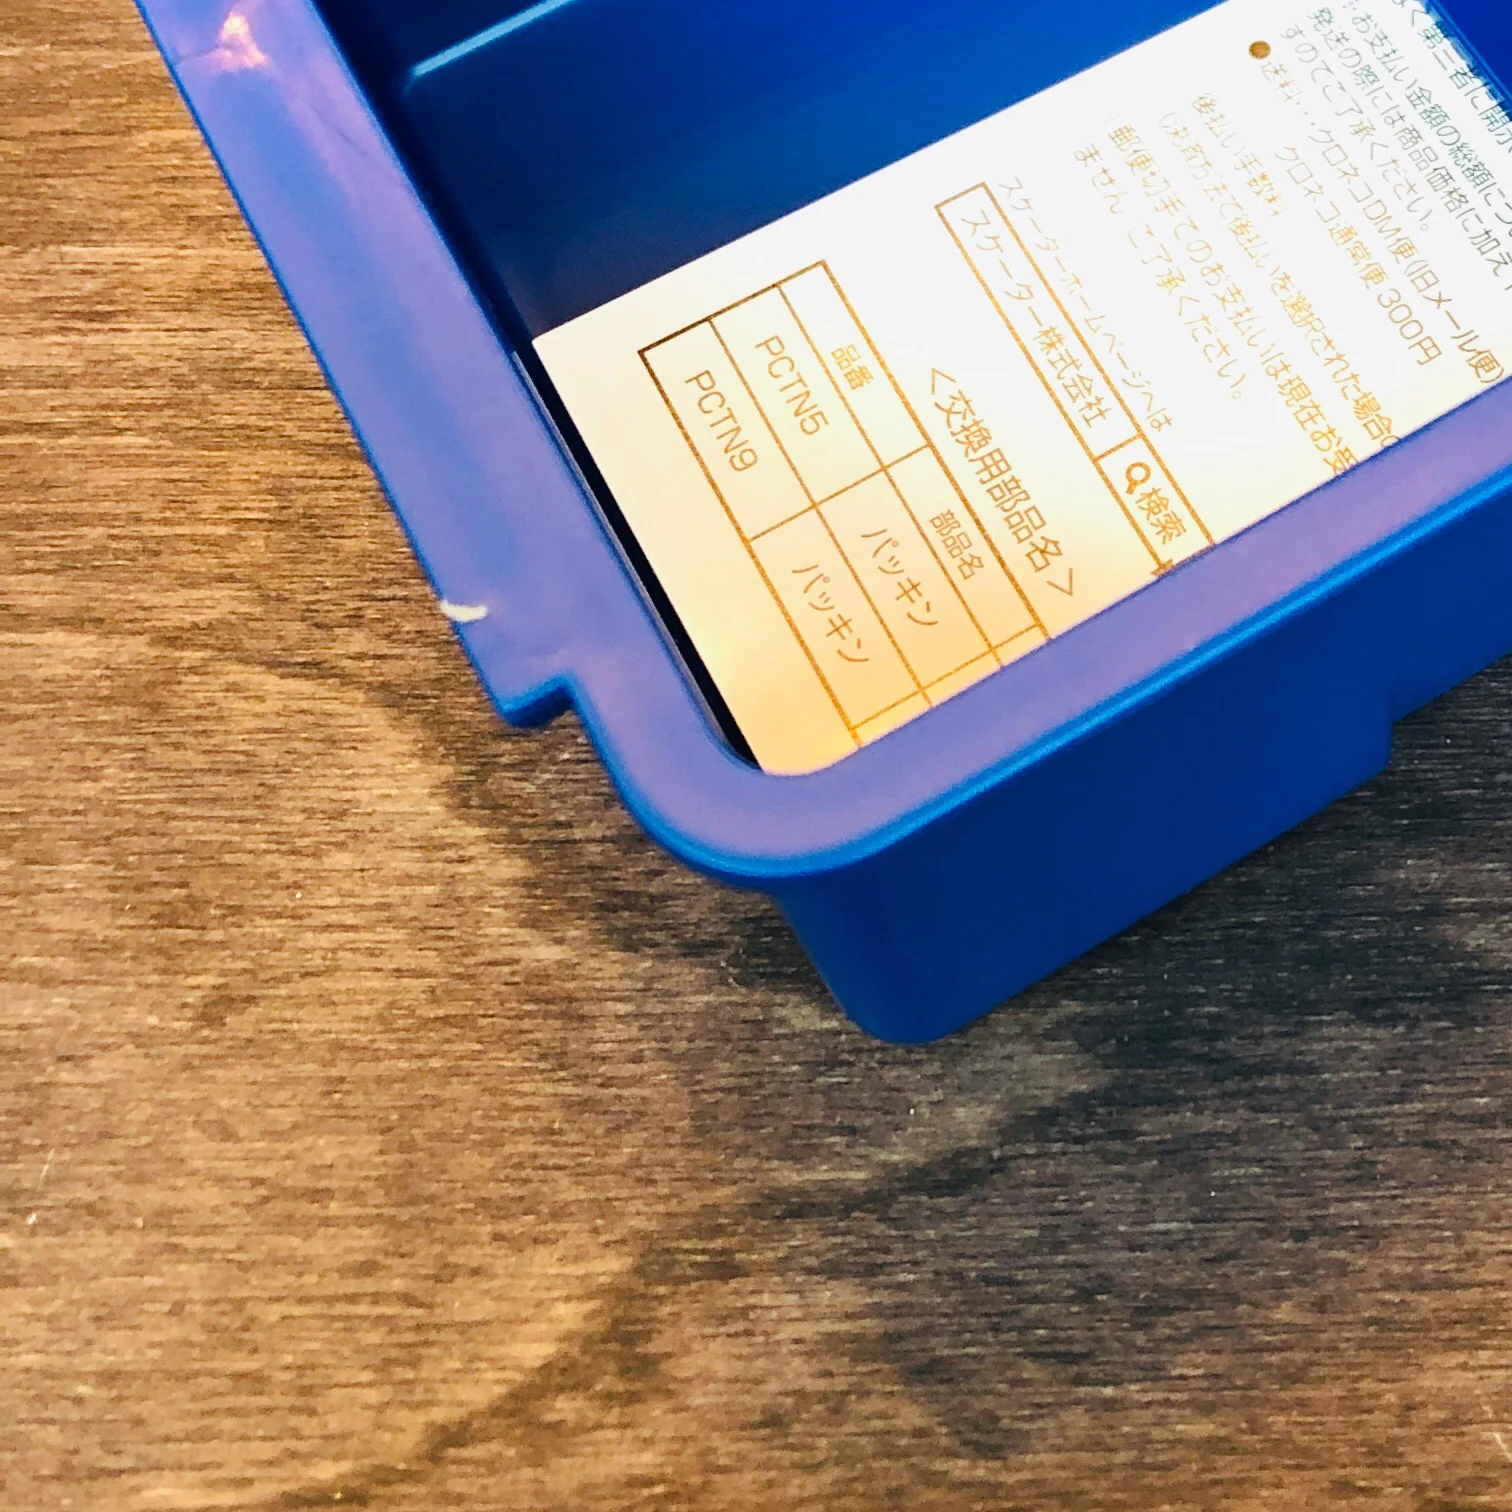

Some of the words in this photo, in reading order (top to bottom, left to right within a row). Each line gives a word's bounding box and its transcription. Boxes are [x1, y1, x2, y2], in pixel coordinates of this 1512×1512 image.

[961, 207, 1109, 430] スケーター株式会社
[998, 175, 1174, 434] スケーターホームページへは
[1376, 287, 1443, 366] 300円
[754, 334, 830, 437] PCTN5
[830, 343, 875, 391] 品番
[685, 369, 759, 474] PCTN9
[928, 507, 985, 582] 部品名
[1135, 485, 1187, 545] 検索
[792, 563, 870, 665] パッキン
[860, 526, 939, 631] パッキン
